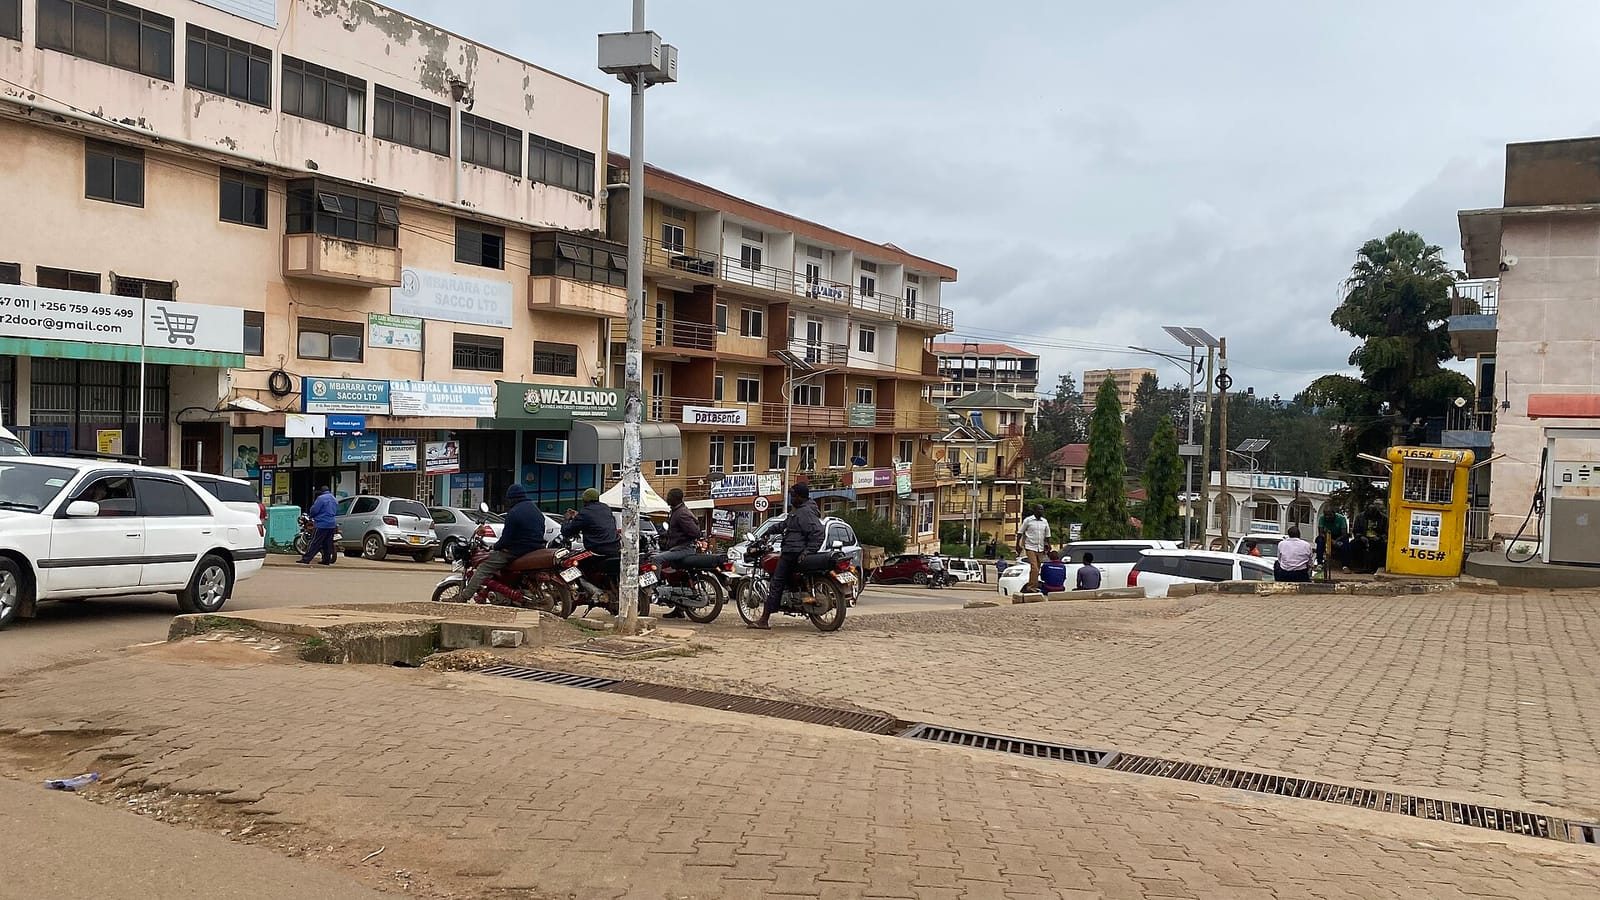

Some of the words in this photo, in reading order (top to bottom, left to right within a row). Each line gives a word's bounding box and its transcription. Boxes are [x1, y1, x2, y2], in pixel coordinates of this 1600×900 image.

[423, 275, 480, 294] MBARARA
[14, 298, 30, 308] 011
[40, 302, 66, 312] +256
[69, 304, 88, 314] 759
[92, 307, 111, 316] 495
[114, 309, 134, 318] 499
[435, 294, 474, 310] SACCO
[478, 299, 498, 312] LTD
[329, 382, 366, 391] MBARARA
[367, 384, 384, 392] COW
[412, 382, 440, 393] MEDICAL
[442, 384, 449, 392] &
[451, 384, 492, 394] LABORATORY
[336, 392, 362, 400] SACCO
[432, 394, 463, 403] SUPPLIES
[540, 388, 618, 406] WAZALENDO
[696, 413, 740, 424] patasente
[733, 475, 756, 486] MEDICAL
